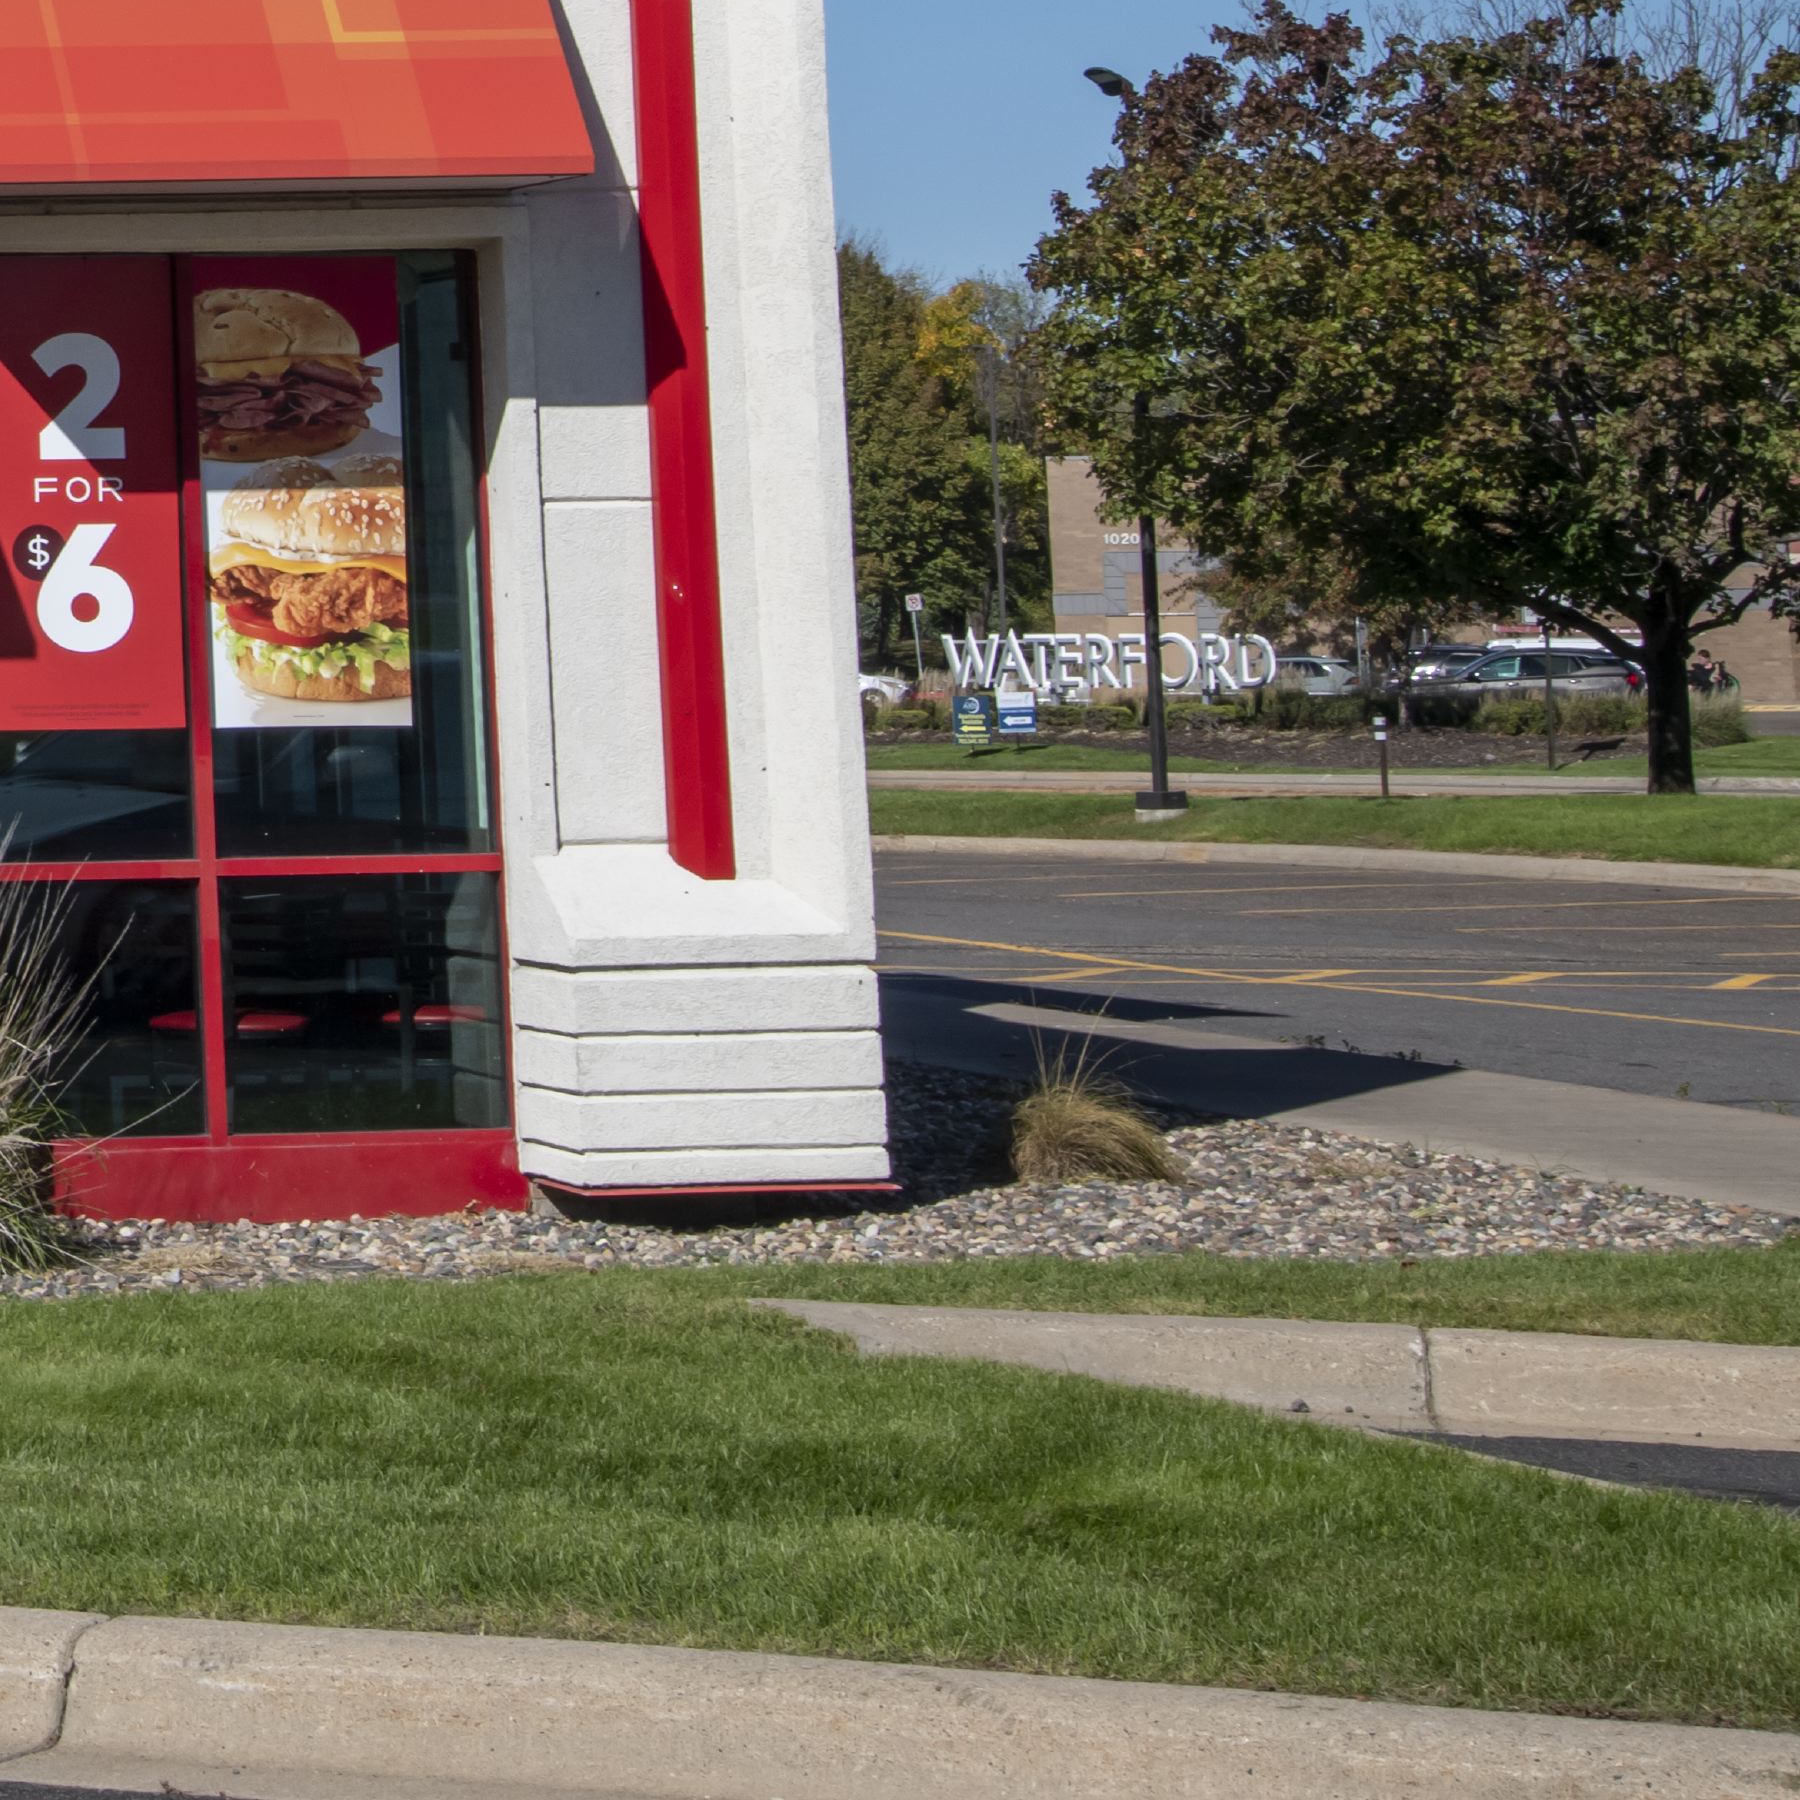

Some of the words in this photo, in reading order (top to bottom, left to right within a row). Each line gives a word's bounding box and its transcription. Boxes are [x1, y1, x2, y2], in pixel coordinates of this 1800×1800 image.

[29, 331, 128, 461] 2
[32, 475, 125, 504] FOR
[1102, 532, 1141, 546] 1020
[940, 625, 1277, 691] WATERFORD
